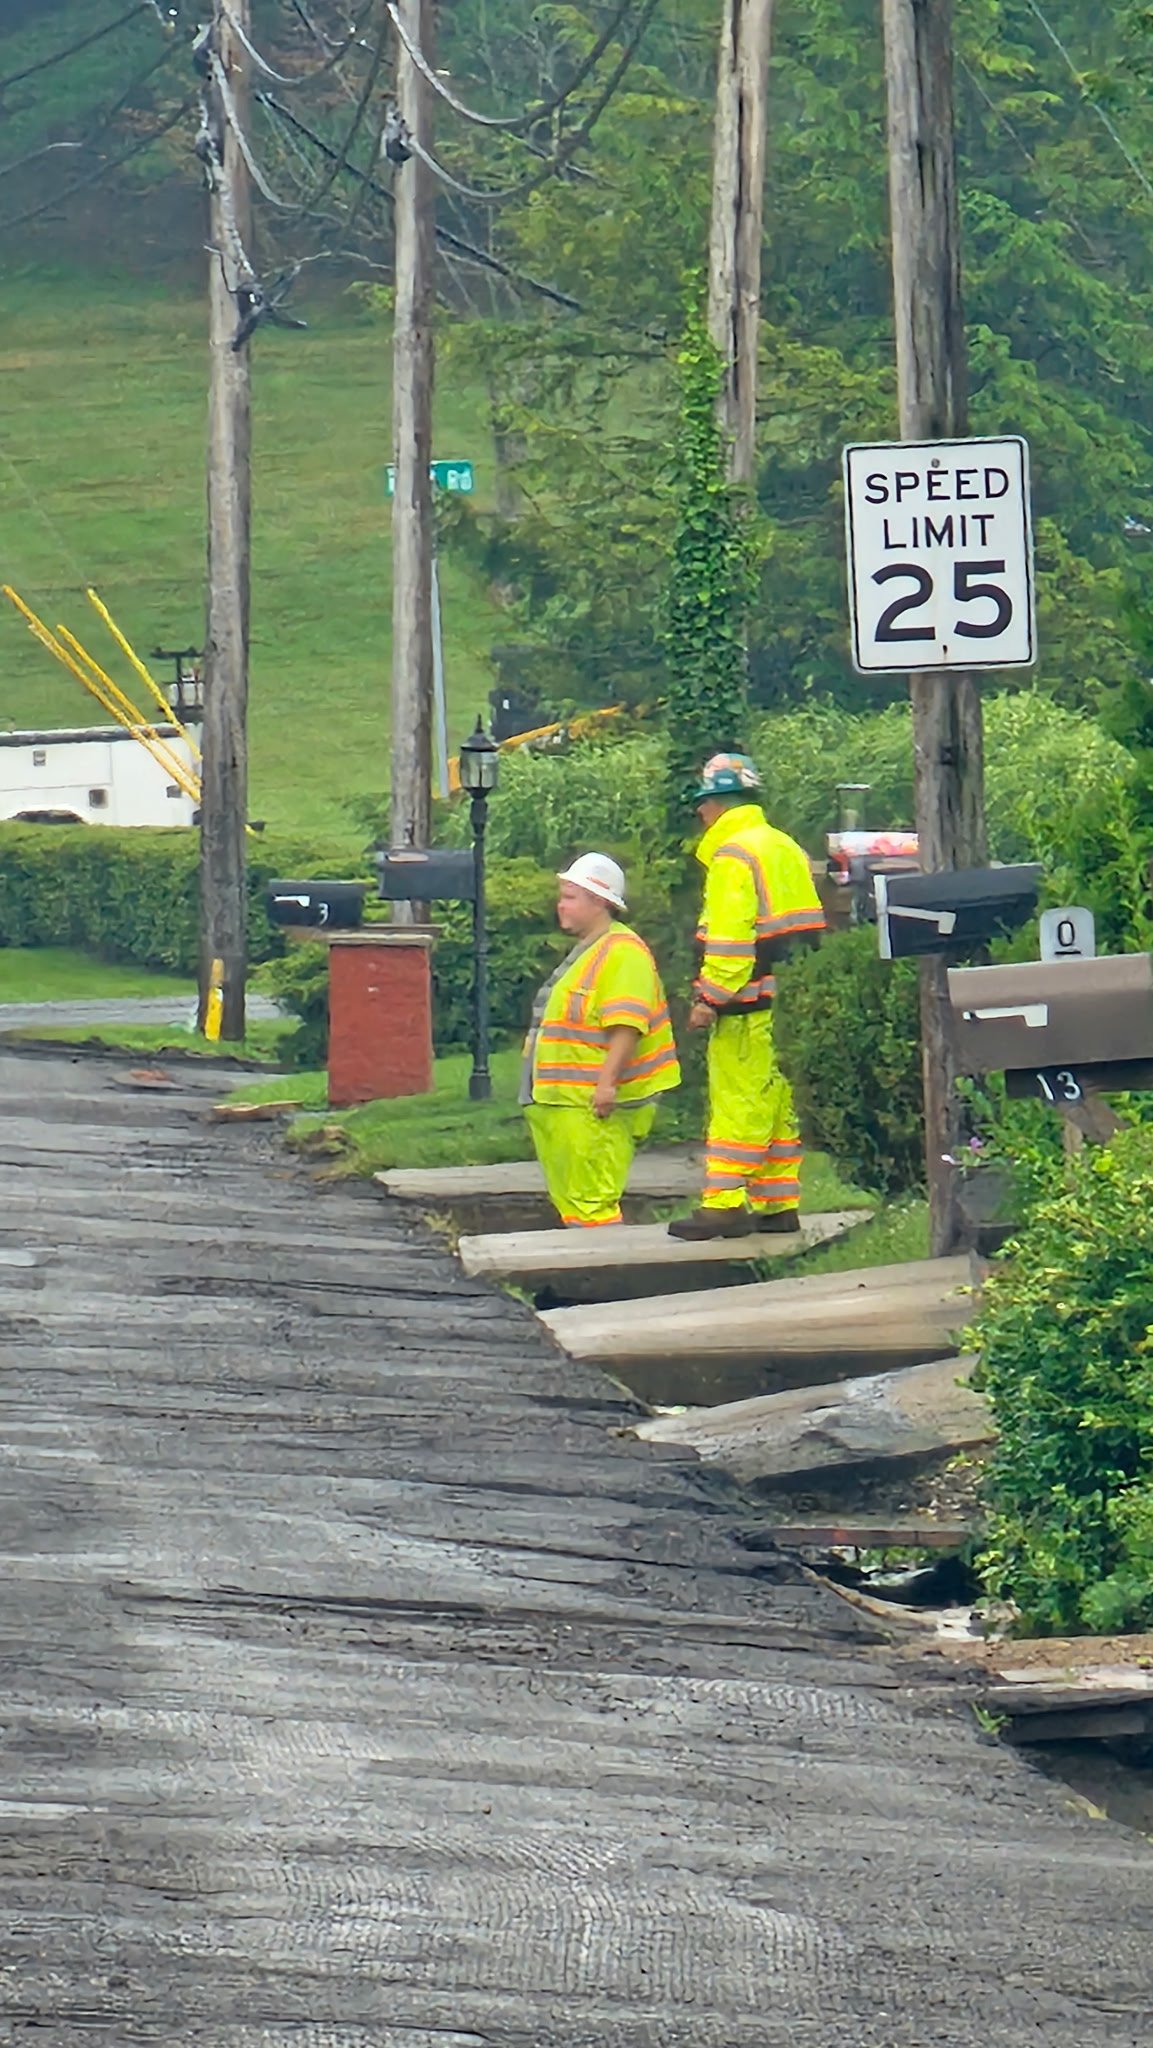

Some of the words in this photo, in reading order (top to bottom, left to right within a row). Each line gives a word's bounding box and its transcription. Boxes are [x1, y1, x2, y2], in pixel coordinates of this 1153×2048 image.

[864, 467, 1010, 505] SPEED
[883, 514, 995, 549] LIMIT
[871, 559, 1013, 643] 25
[1036, 1071, 1080, 1101] 13
